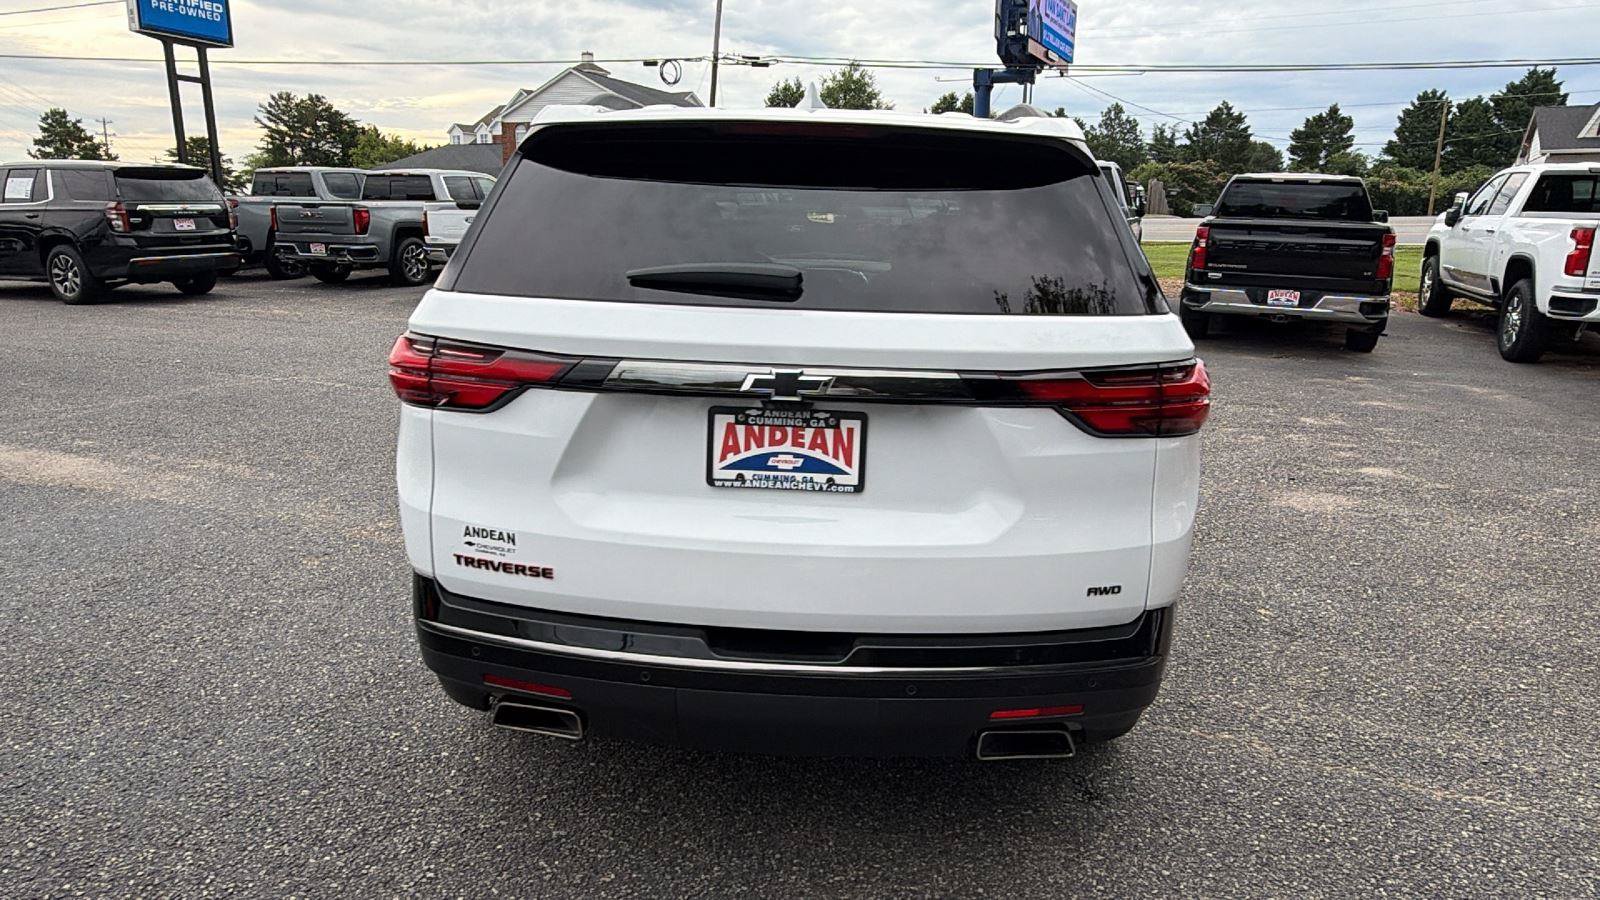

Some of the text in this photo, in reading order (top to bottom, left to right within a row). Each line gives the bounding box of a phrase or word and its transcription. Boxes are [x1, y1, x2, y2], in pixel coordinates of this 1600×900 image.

[151, 0, 221, 22] PRE-OWNED
[163, 0, 224, 13] TIFIED
[763, 410, 811, 419] ANDEAN
[810, 418, 826, 428] GA
[718, 421, 855, 469] ANDEAN
[714, 479, 855, 493] www.ANDEANCHEVY.com
[463, 525, 516, 545] ANDEAN
[453, 553, 555, 580] TRAVERSE
[1087, 585, 1121, 598] AWD
